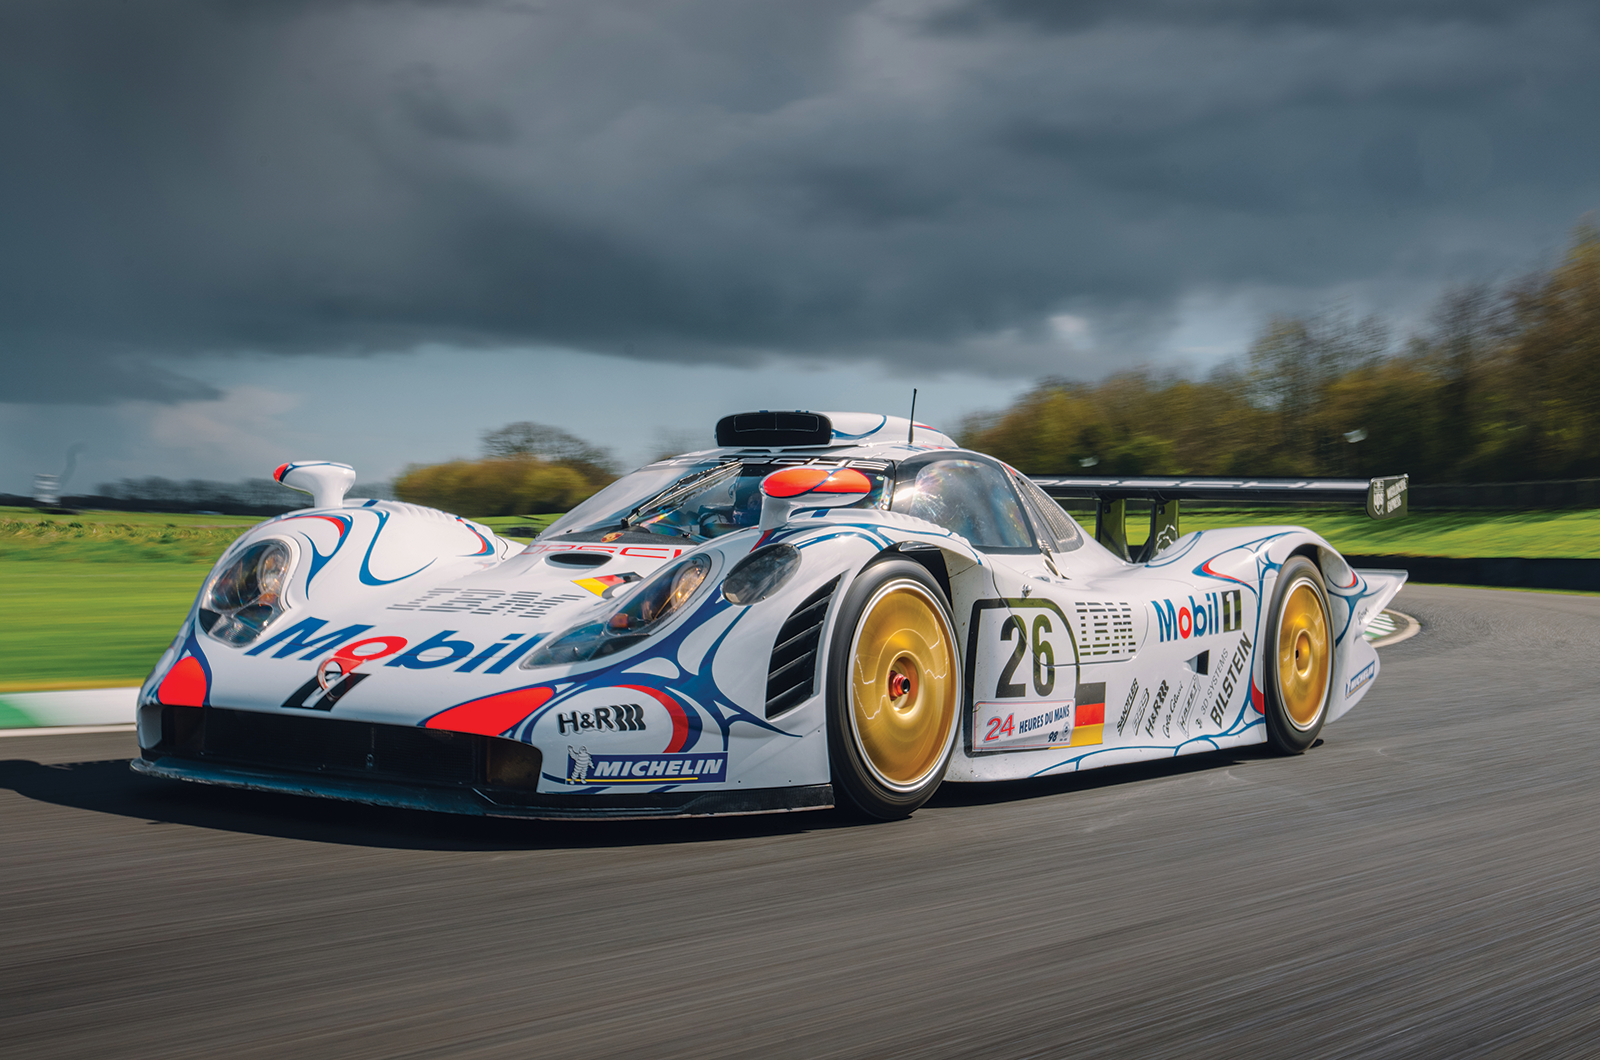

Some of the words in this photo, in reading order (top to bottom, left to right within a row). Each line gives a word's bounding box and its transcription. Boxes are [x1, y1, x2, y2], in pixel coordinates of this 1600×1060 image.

[520, 544, 683, 560] ORSC
[386, 587, 587, 619] IBM
[1150, 592, 1219, 643] Mobil
[242, 616, 554, 675] Mobil
[1075, 602, 1137, 657] IBM
[995, 613, 1056, 699] 26
[1207, 647, 1229, 697] SYSTEMS
[1209, 631, 1253, 730] BILSTEIN
[557, 706, 614, 736] H&R
[983, 711, 1016, 744] 24
[1018, 714, 1045, 735] HEURES
[1044, 711, 1054, 726] DU
[1053, 704, 1071, 722] MANS
[1047, 730, 1059, 743] 98
[593, 758, 723, 777] MICHELIN
